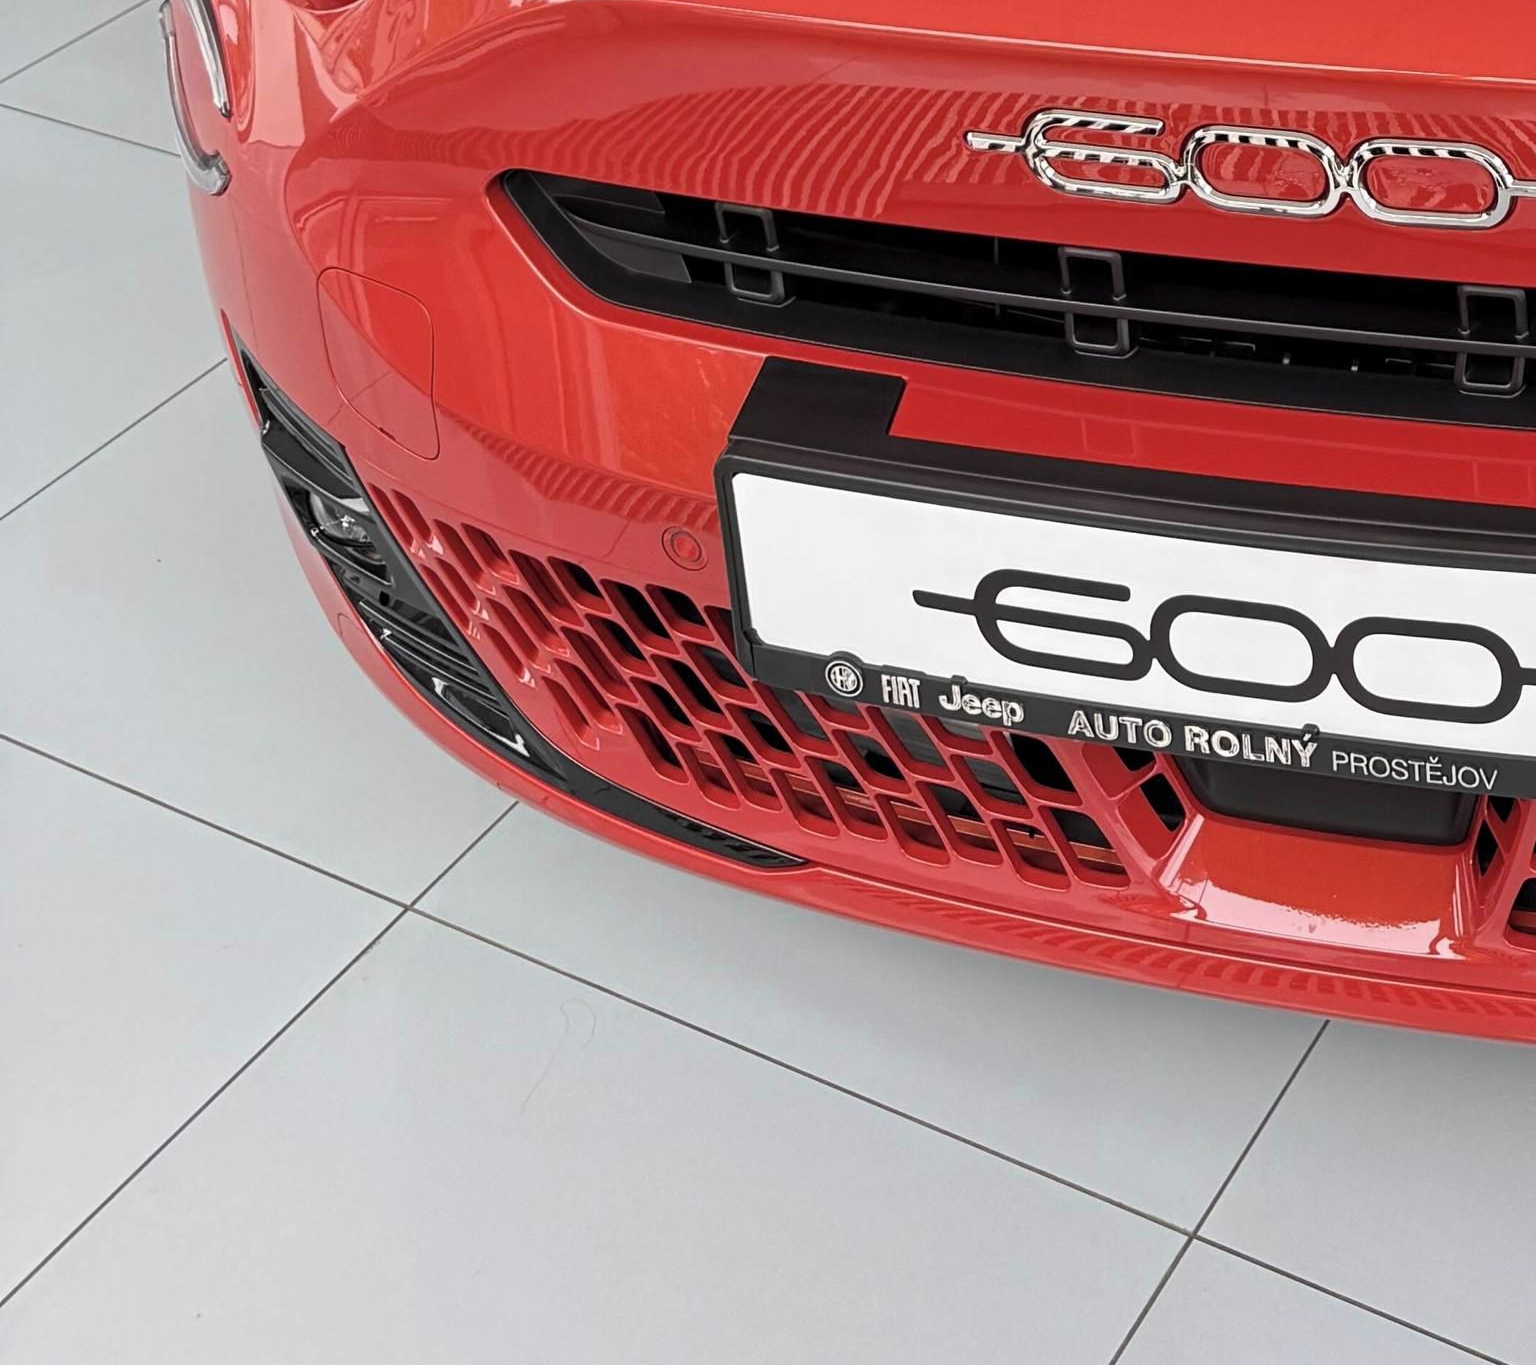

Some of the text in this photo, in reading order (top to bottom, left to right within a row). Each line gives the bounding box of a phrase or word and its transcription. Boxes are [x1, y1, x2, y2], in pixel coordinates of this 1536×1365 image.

[881, 674, 921, 709] FIAT
[938, 684, 1025, 726] Jeep
[1067, 709, 1173, 748] AUTO
[1184, 723, 1319, 768] ROLNÝ
[1331, 750, 1500, 791] PROSTĚJOV
